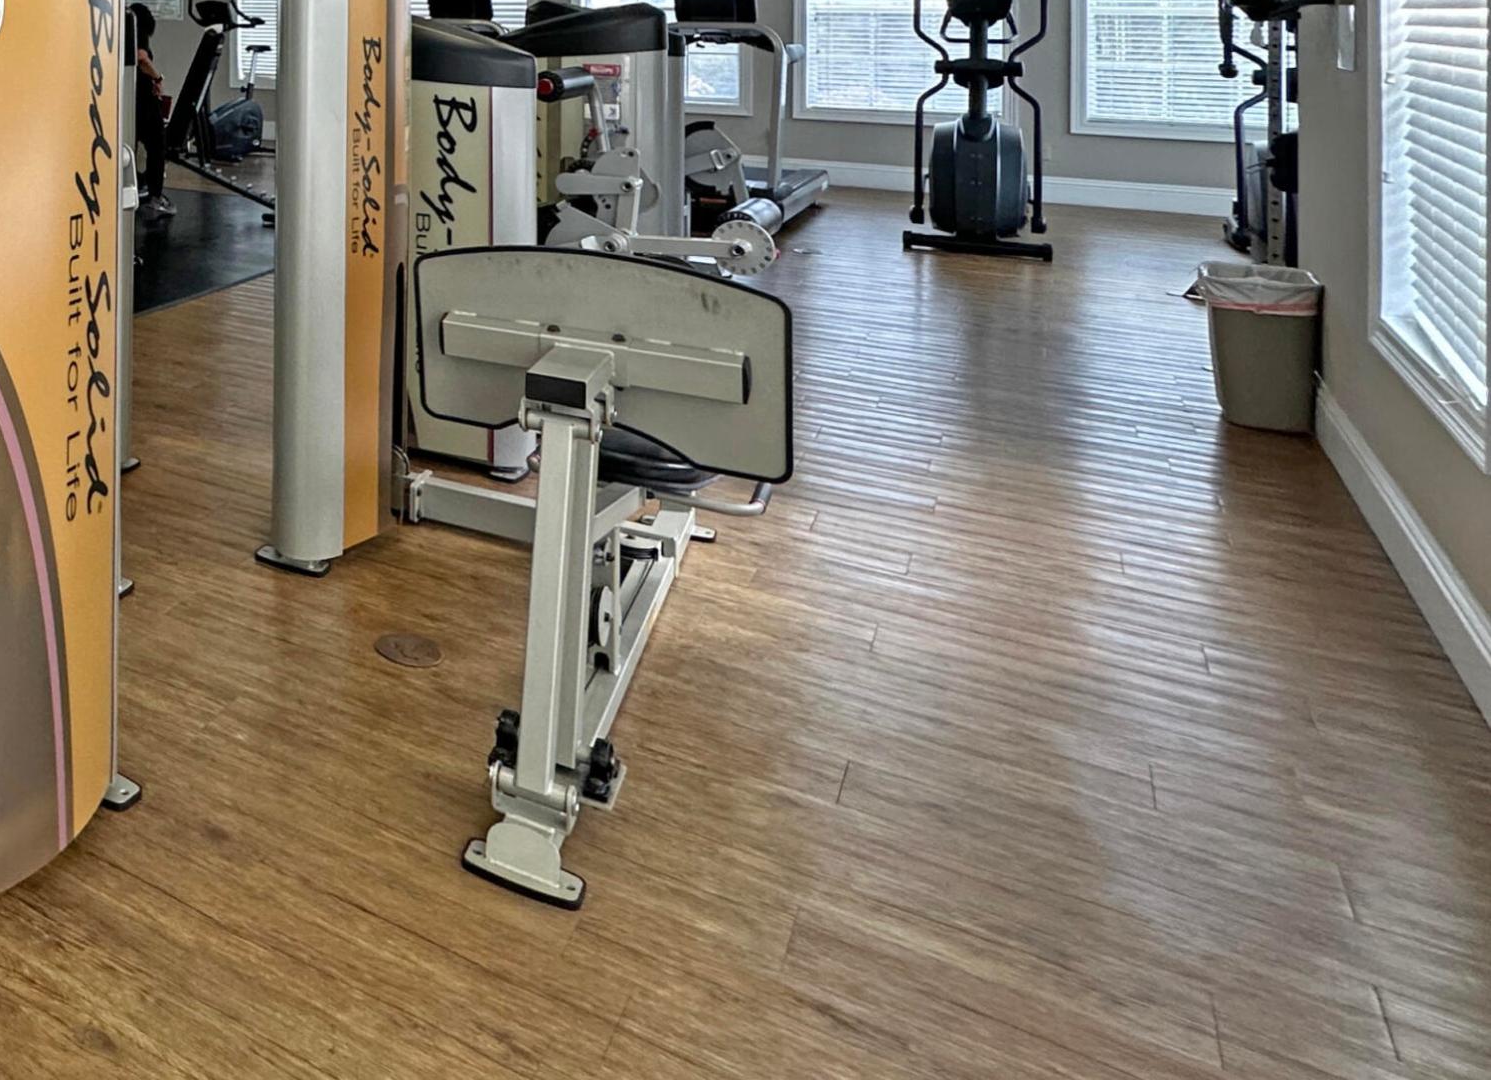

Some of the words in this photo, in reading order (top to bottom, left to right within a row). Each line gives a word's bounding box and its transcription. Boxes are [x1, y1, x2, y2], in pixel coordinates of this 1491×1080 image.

[352, 128, 361, 173] Built
[355, 36, 381, 258] Body-Solid
[420, 94, 477, 246] Body-
[351, 180, 361, 212] for
[351, 217, 360, 254] Life
[68, 214, 84, 326] Built
[67, 343, 82, 412] for
[66, 431, 81, 521] Life
